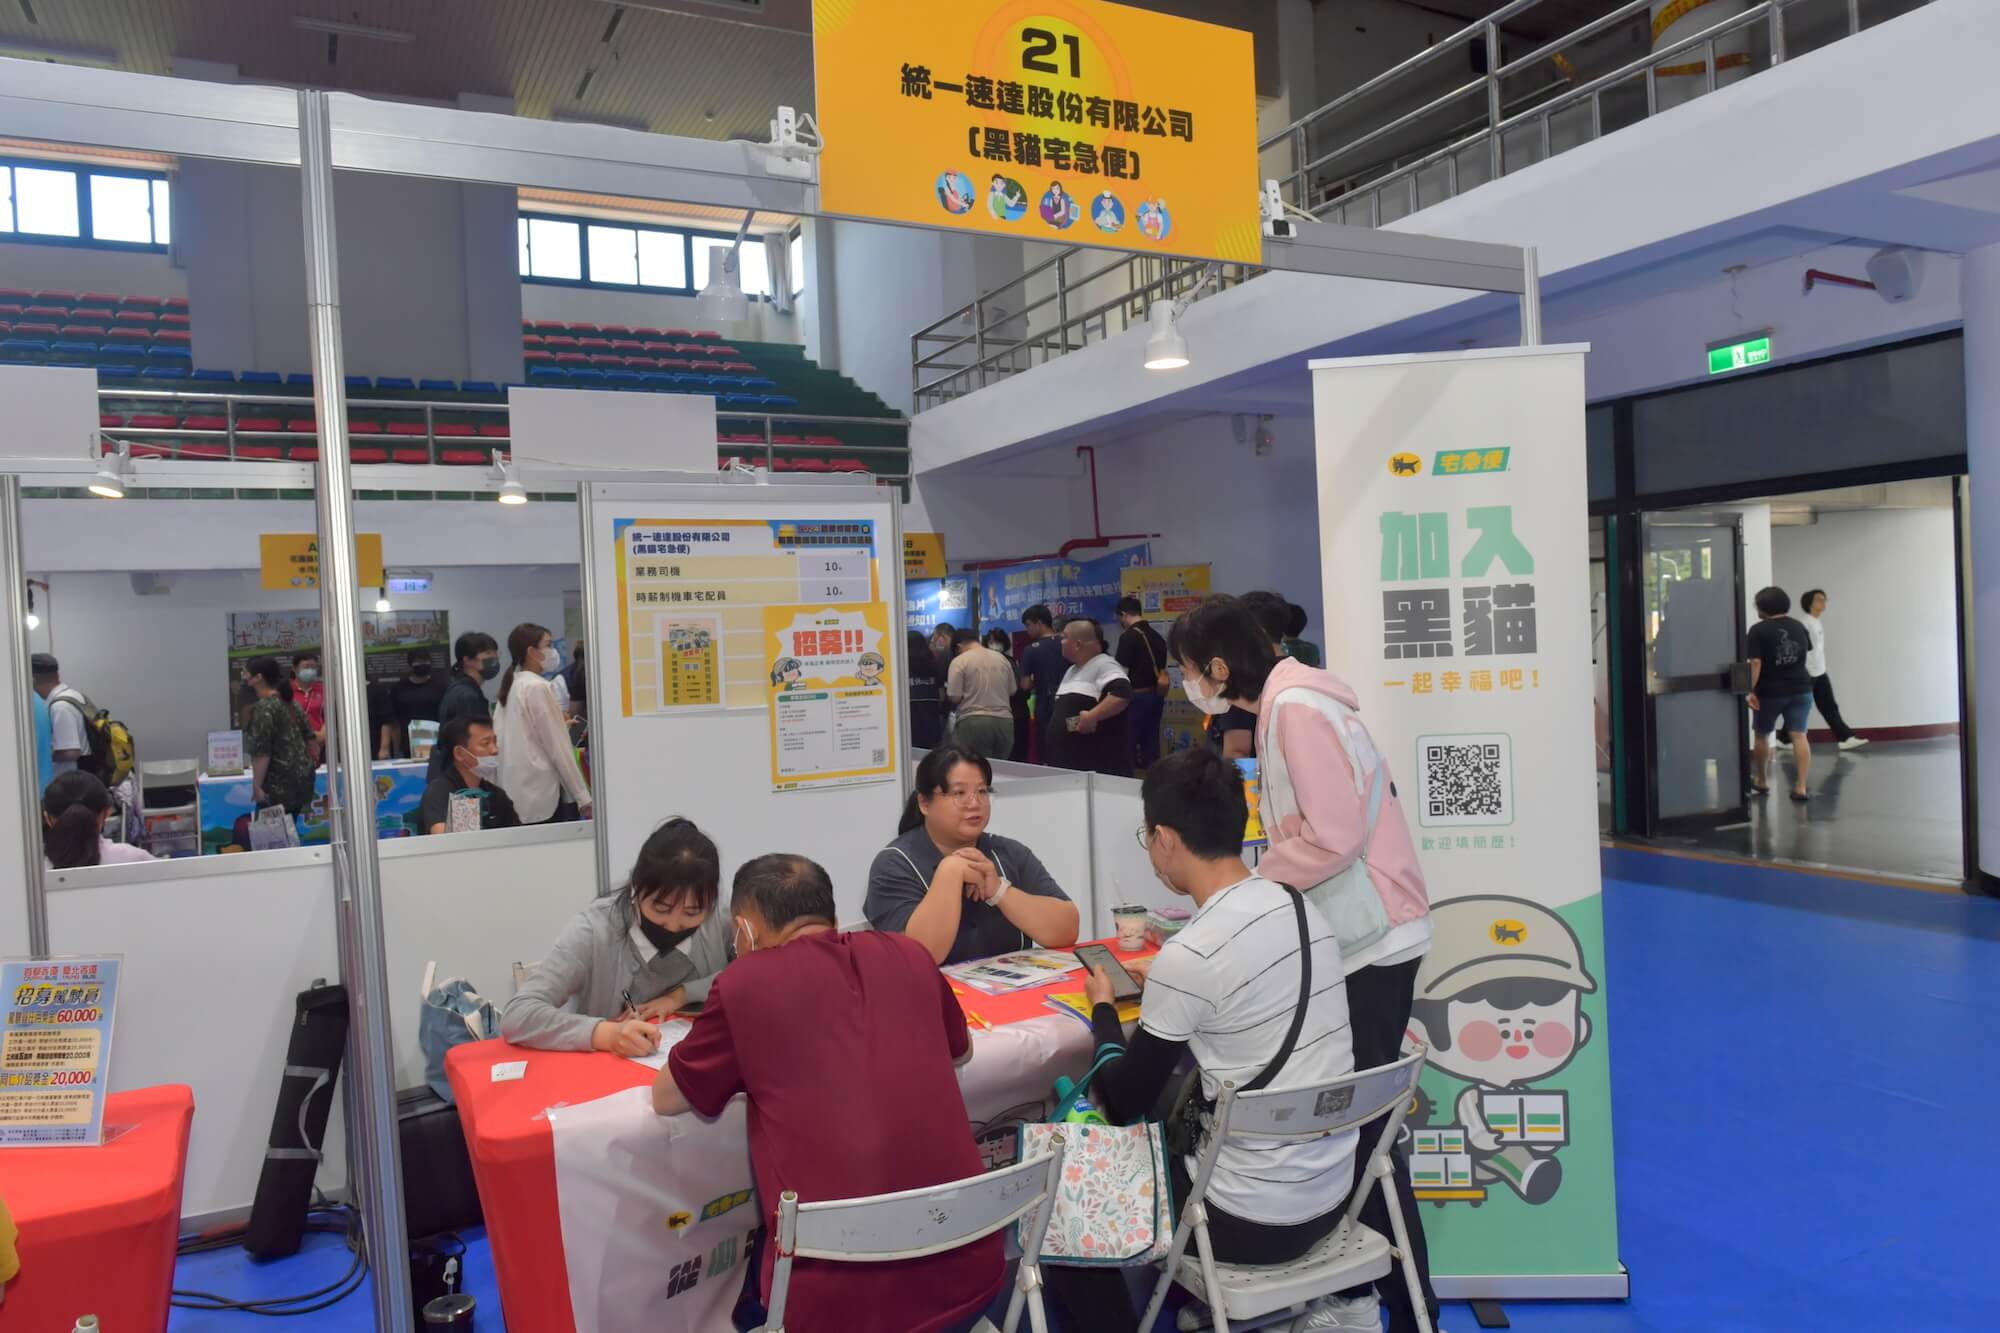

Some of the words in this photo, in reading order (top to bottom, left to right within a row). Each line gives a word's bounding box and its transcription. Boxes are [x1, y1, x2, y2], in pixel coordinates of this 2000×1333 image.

[1021, 27, 1081, 79] 21
[900, 62, 1194, 142] 統一速達股份有限公司
[632, 531, 731, 543] 統一速達股份有限公司
[1379, 505, 1535, 581] 加入
[635, 566, 681, 578] 業務司機
[635, 590, 727, 603] 時薪制機車宅配員
[1382, 583, 1538, 660] 黑貓
[792, 629, 865, 657] 招募!!
[57, 1008, 98, 1023] 60,000
[50, 1070, 92, 1086] 20,000
